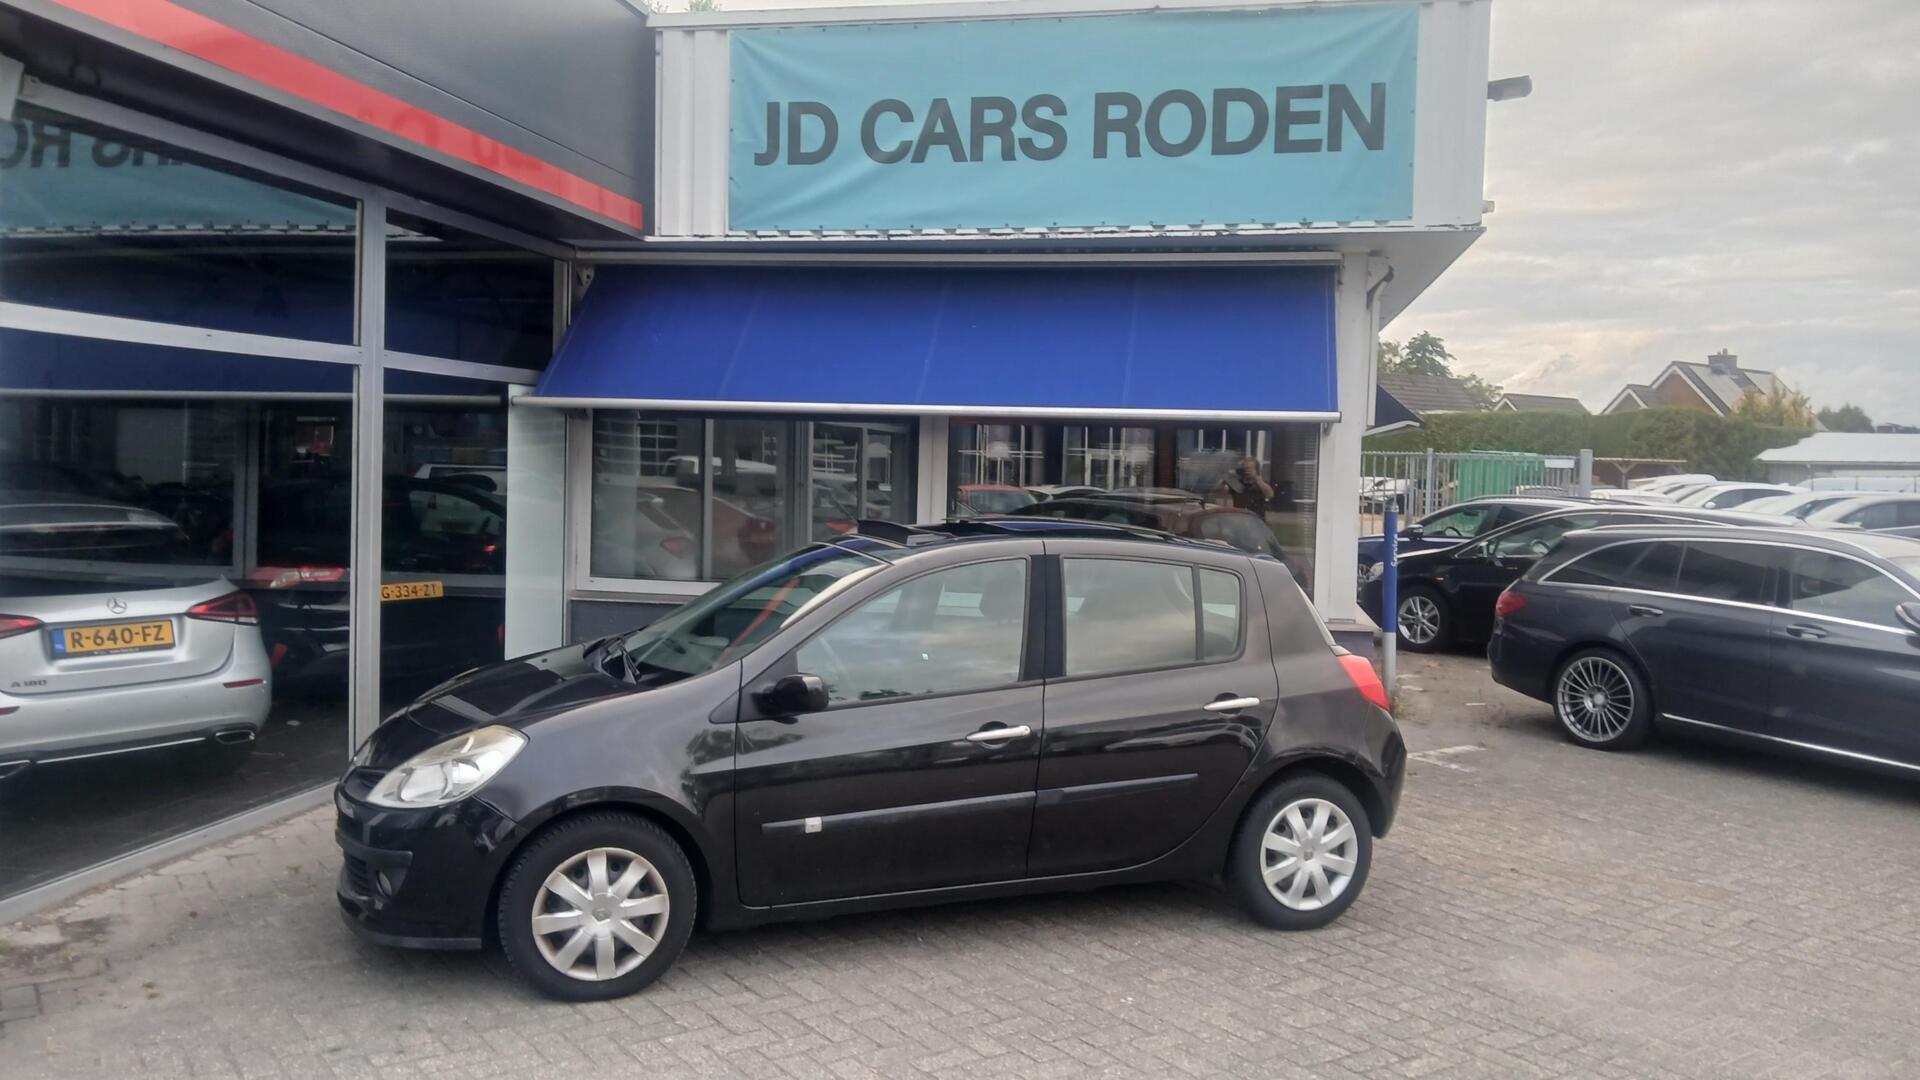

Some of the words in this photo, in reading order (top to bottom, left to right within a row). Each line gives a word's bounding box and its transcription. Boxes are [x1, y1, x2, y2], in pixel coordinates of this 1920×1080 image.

[754, 101, 839, 166] JD
[860, 93, 1068, 164] CARS
[1092, 82, 1386, 160] RODEN
[71, 624, 165, 649] R-640-FZ
